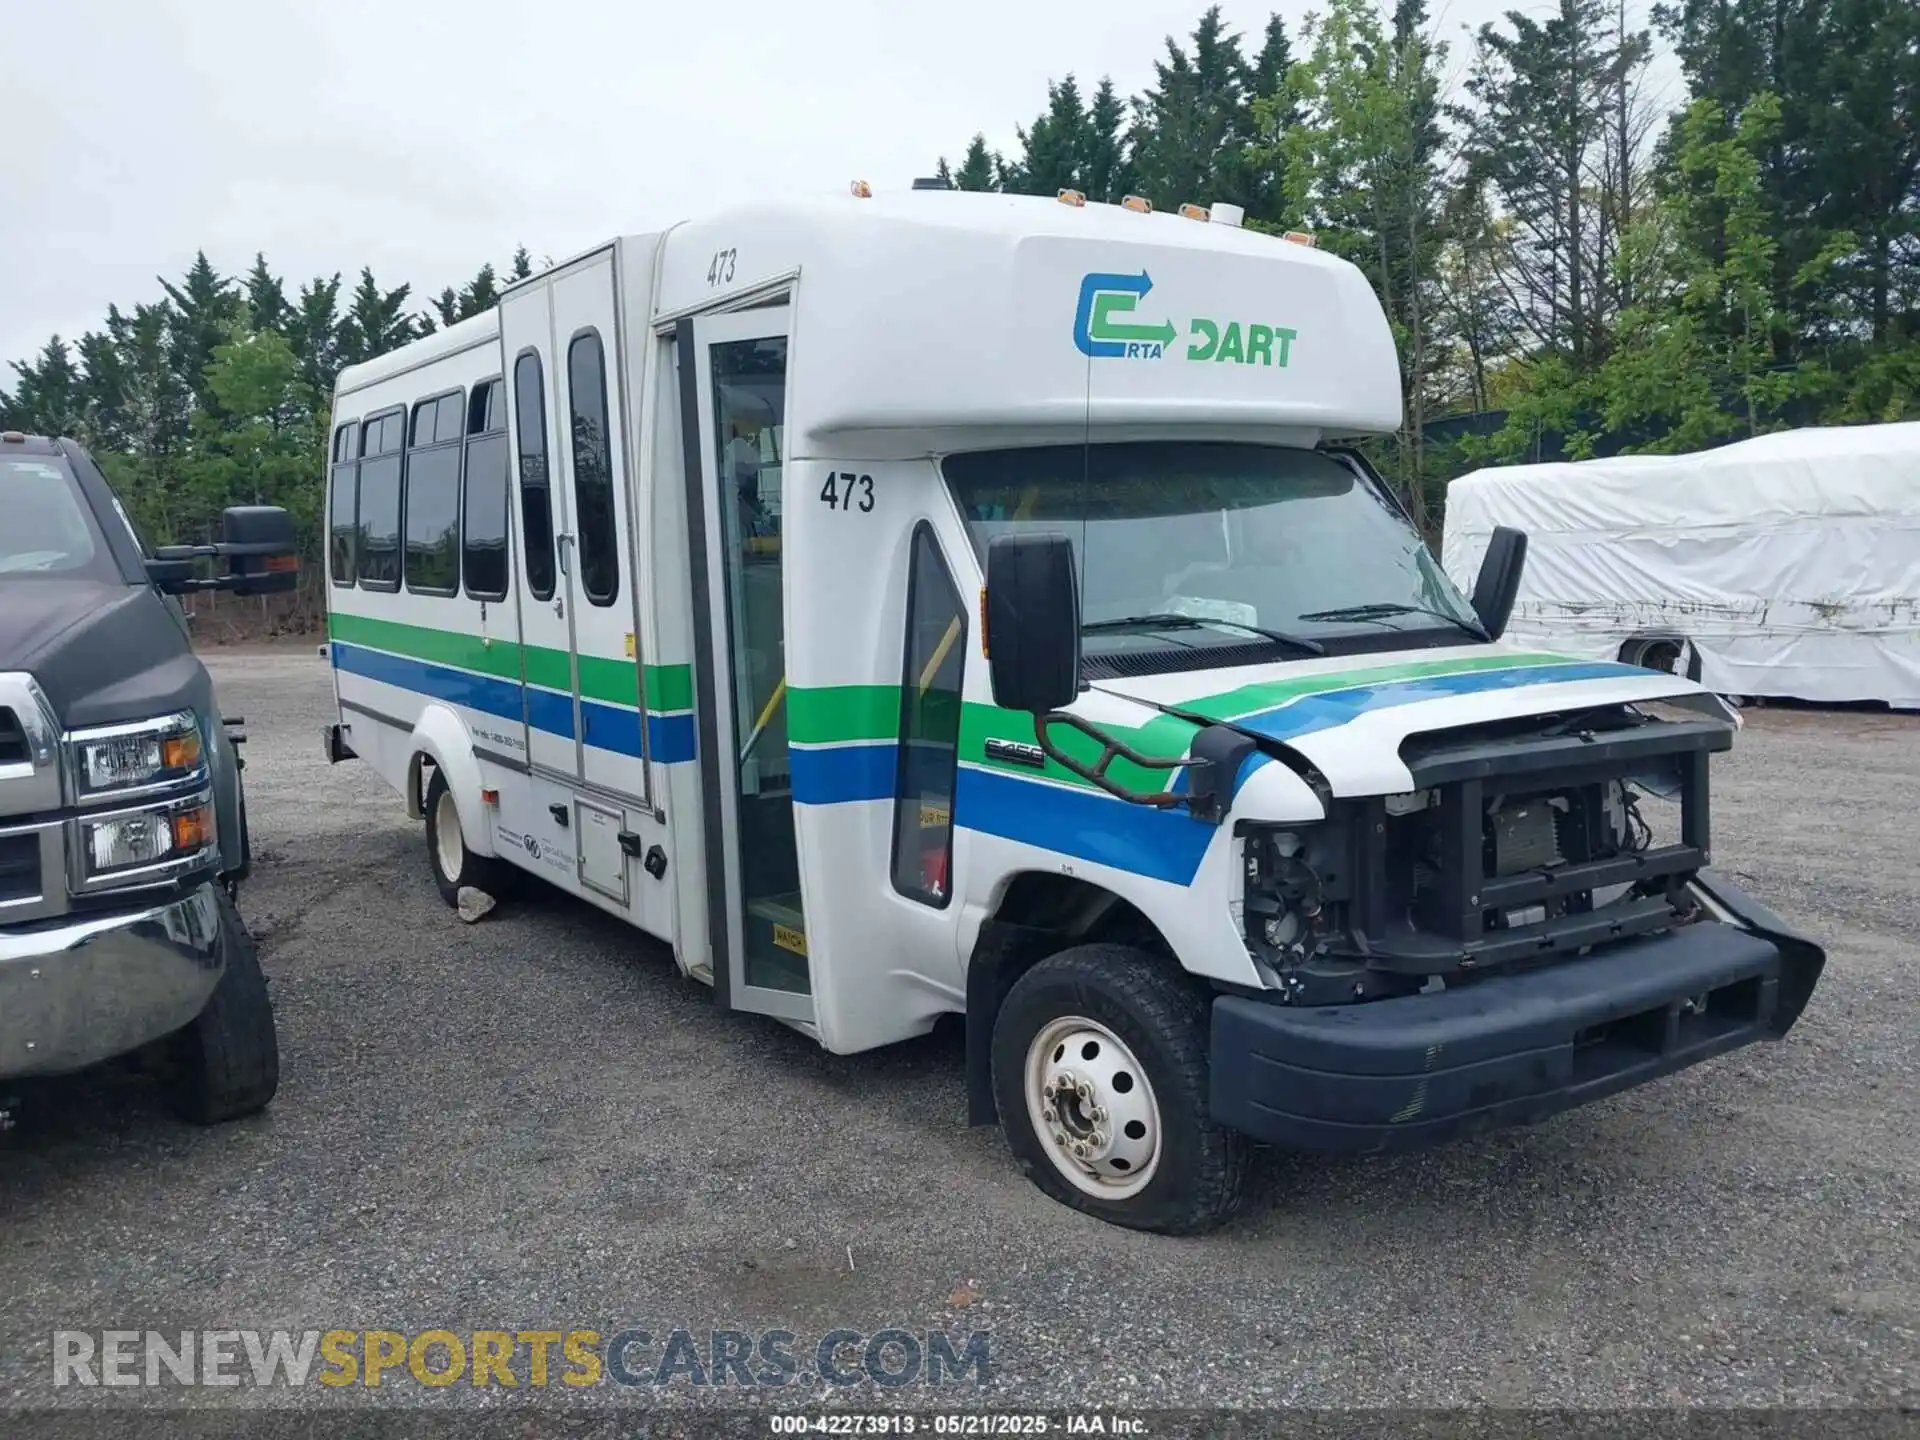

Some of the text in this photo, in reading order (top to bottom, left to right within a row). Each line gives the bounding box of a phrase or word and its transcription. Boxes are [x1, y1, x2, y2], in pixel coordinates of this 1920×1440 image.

[706, 247, 738, 288] 473
[1126, 342, 1163, 360] RTA
[1187, 318, 1298, 368] DART
[820, 471, 875, 513] 473
